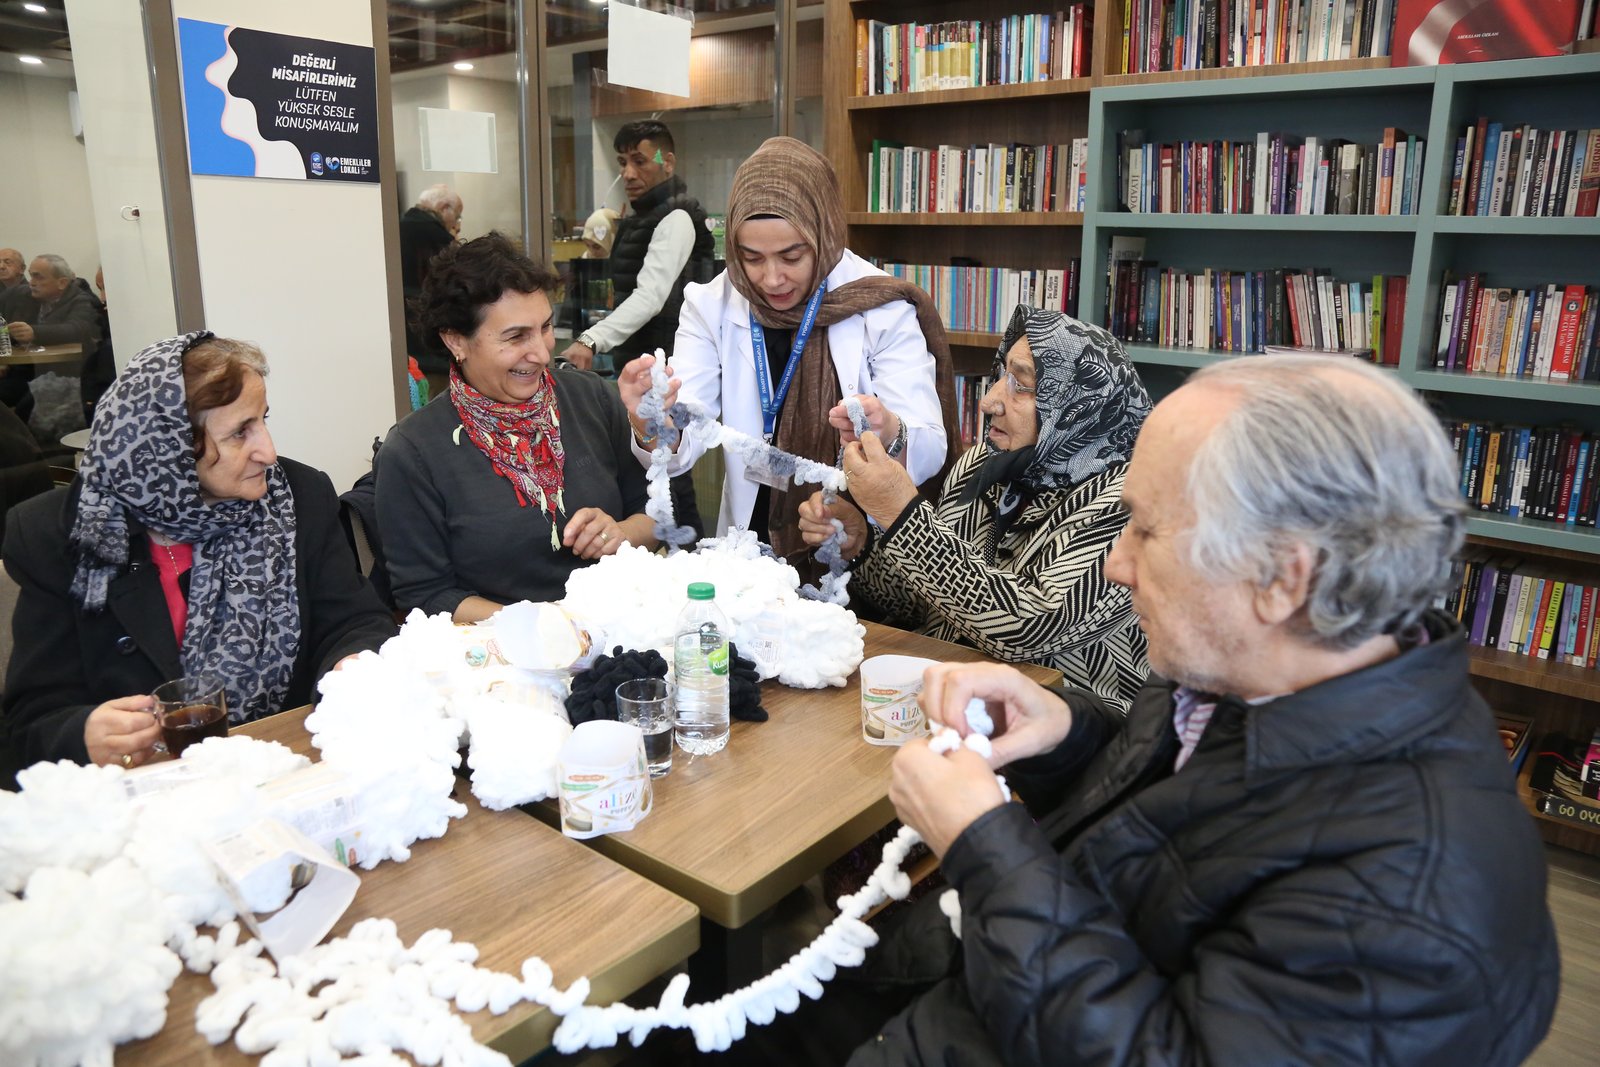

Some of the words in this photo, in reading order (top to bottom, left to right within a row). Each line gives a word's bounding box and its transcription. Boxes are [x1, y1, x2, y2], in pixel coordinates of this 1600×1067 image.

[292, 53, 336, 71] DEĞERLİ
[272, 66, 357, 88] MİSAFİRLERİMİZ
[295, 87, 337, 103] LÜTFEN
[278, 99, 320, 116] YÜKSEK
[322, 103, 356, 119] SESLE
[275, 115, 359, 134] KONUŞMAYALIM
[1559, 804, 1575, 817] GO
